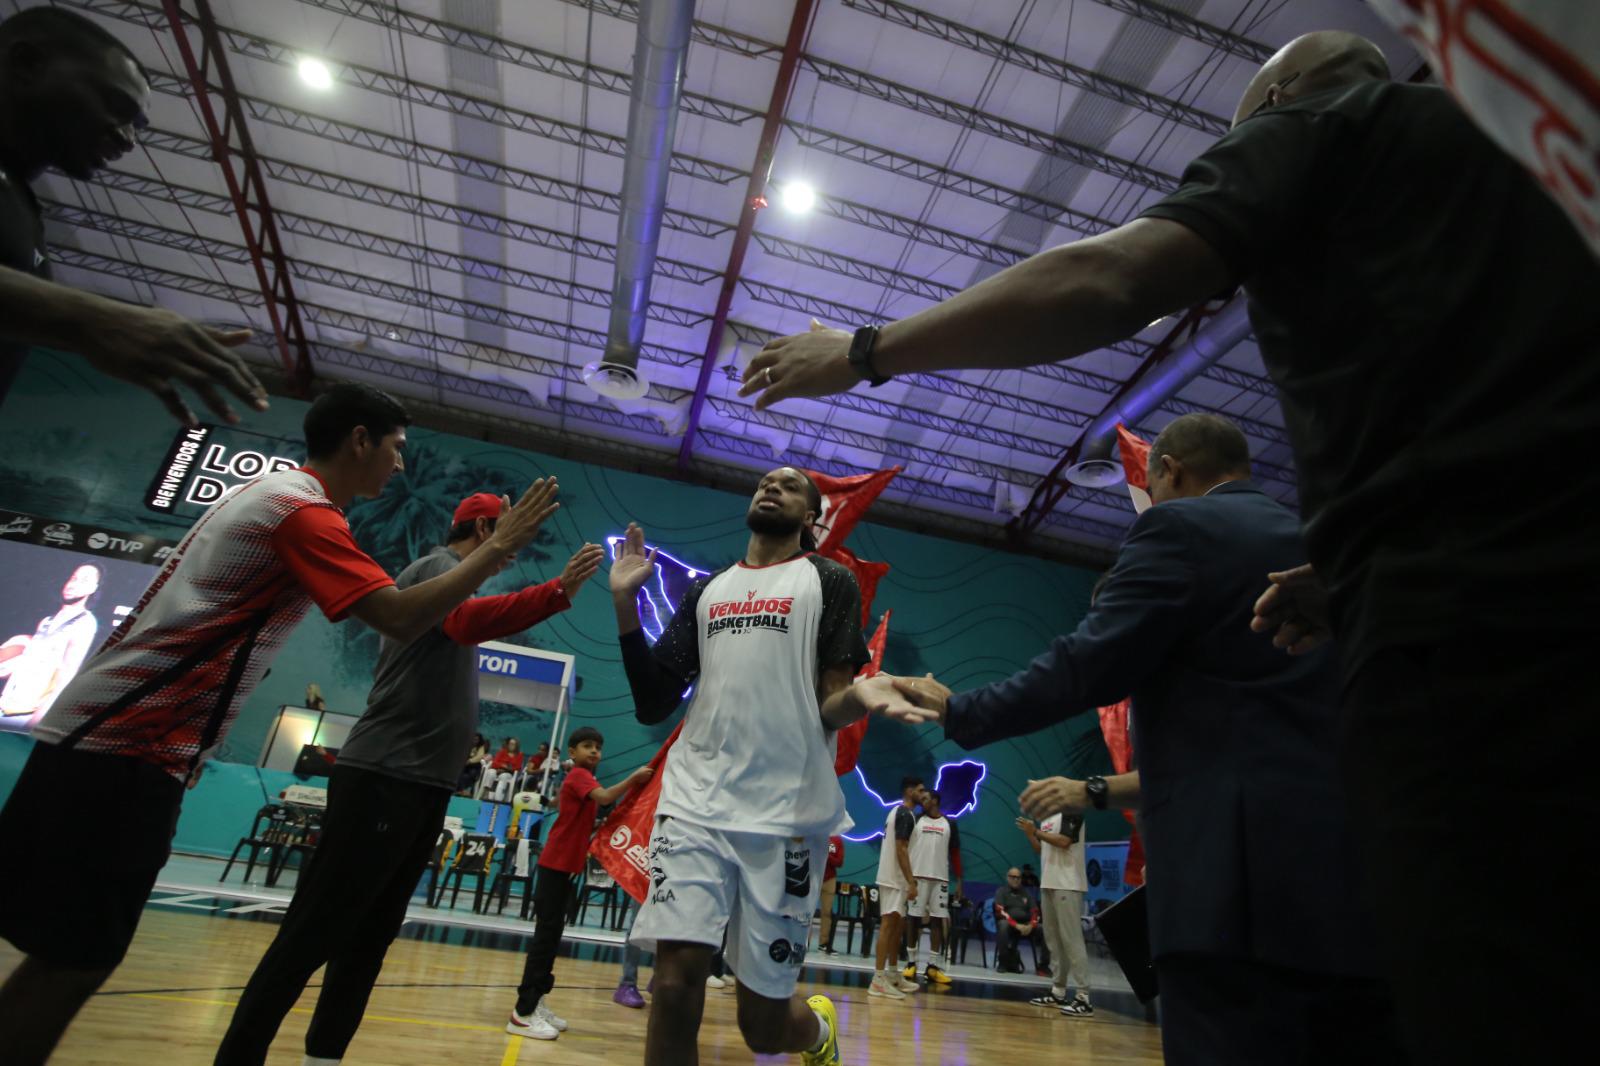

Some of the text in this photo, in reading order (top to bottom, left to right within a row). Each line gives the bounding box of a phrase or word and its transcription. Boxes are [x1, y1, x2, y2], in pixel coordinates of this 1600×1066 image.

[152, 441, 199, 507] BIENVENIDOS
[188, 427, 207, 441] AL
[186, 475, 245, 505] D
[108, 537, 144, 553] TVP
[709, 599, 792, 620] VENADOS
[707, 615, 788, 635] BASKETBALL
[464, 841, 486, 856] 24
[869, 888, 879, 902] 9
